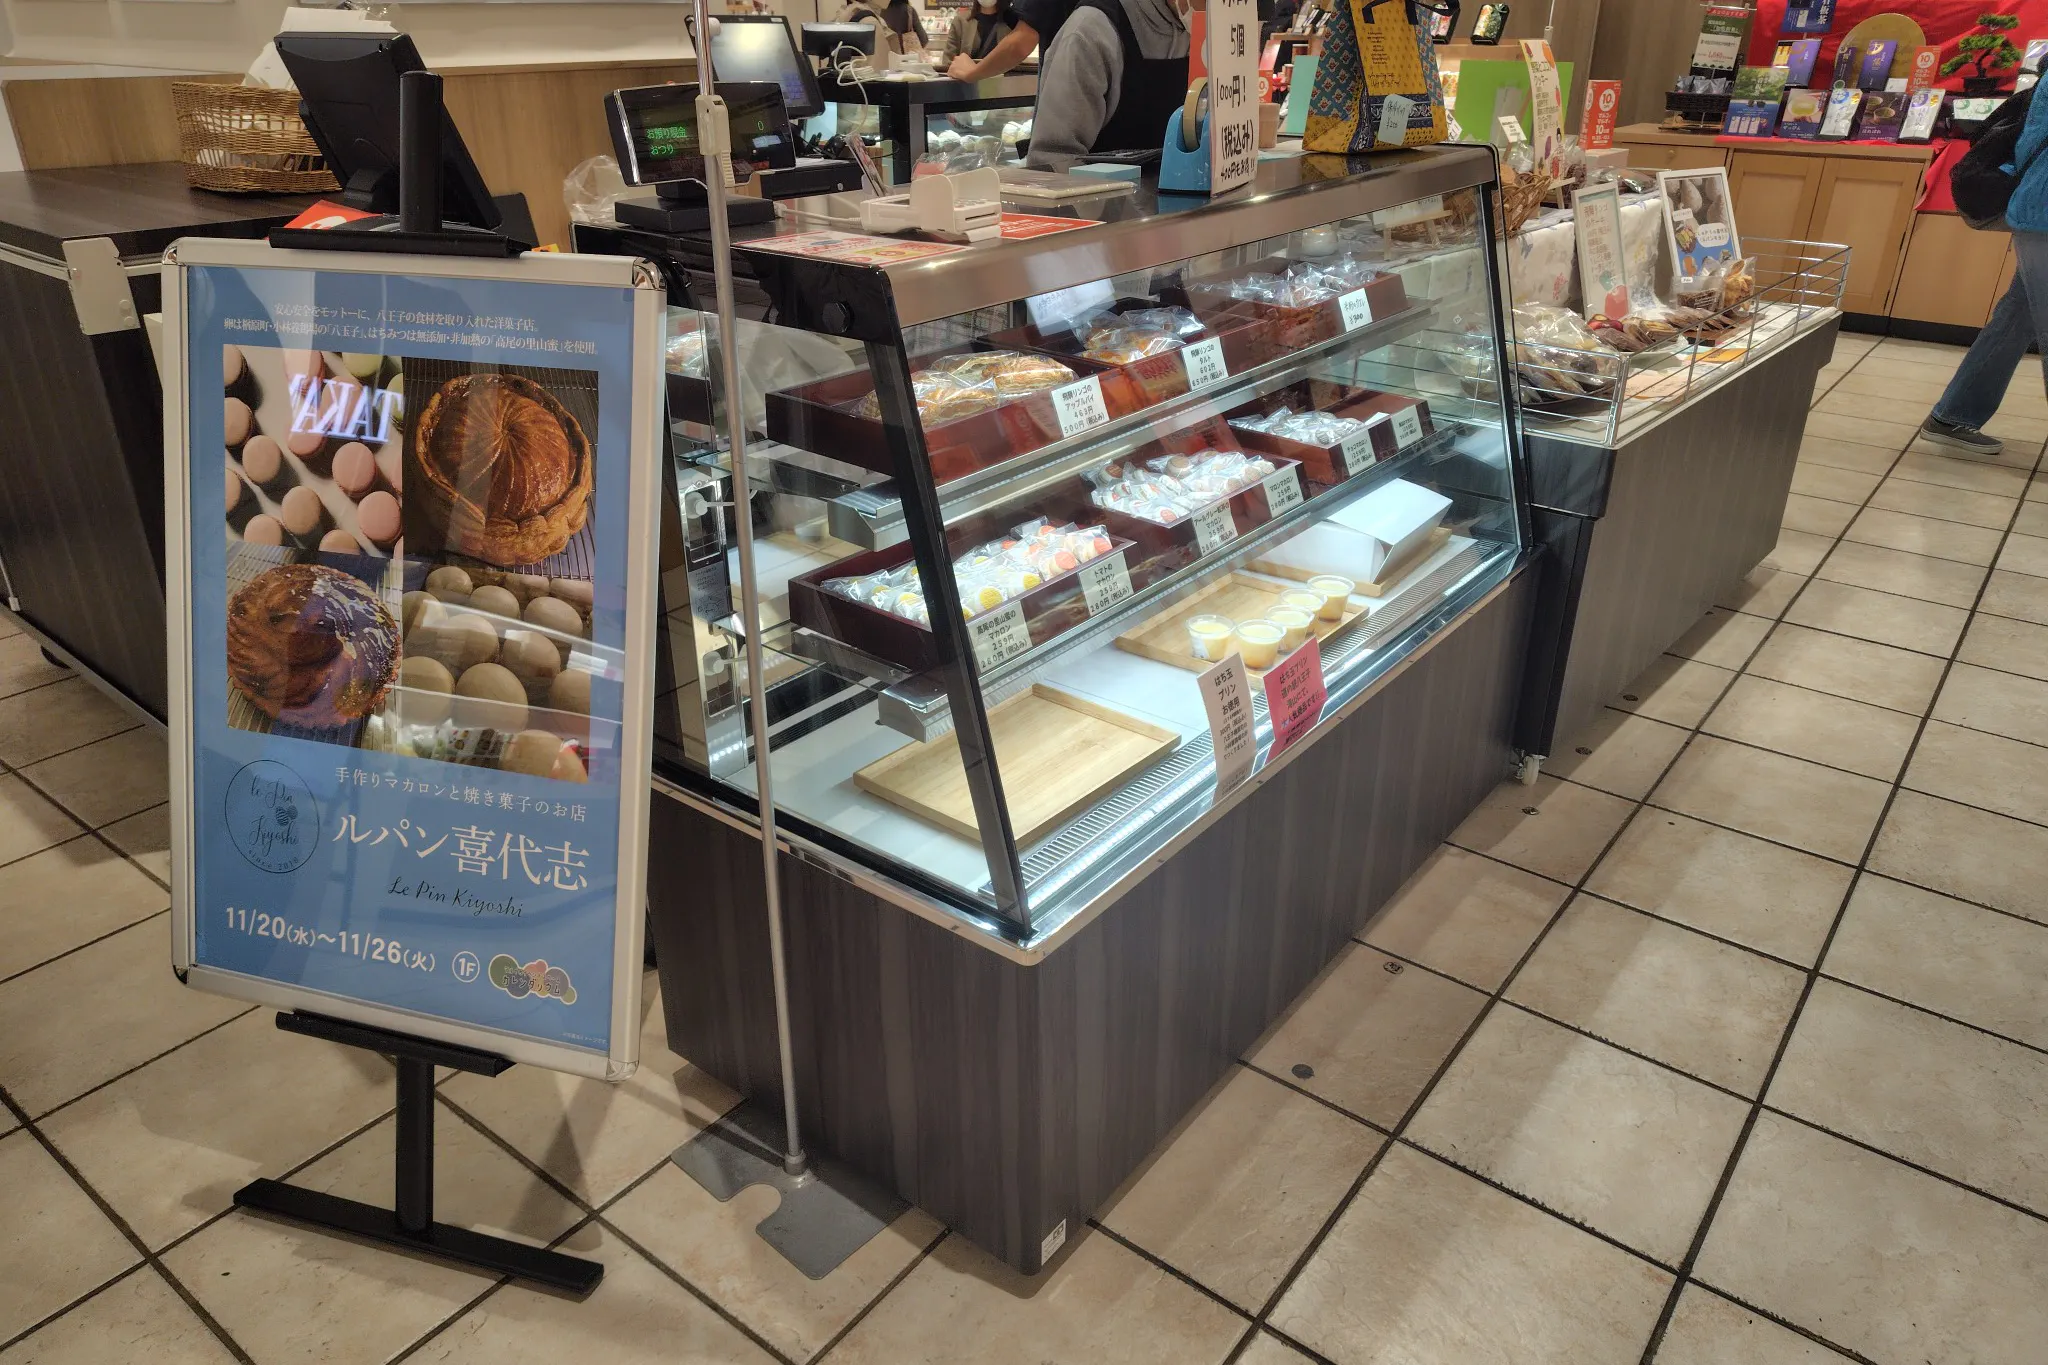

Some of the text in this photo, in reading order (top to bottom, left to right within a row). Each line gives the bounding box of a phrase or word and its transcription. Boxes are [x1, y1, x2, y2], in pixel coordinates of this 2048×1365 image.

[1230, 23, 1245, 57] 5個
[1216, 75, 1246, 108] 1000円!
[646, 126, 687, 140] お預り現金
[1222, 119, 1254, 160] (税込み)
[650, 145, 675, 156] おつり
[1074, 406, 1094, 418] 463円
[1095, 563, 1113, 578] トマトの
[988, 624, 1011, 639] マカロン
[1214, 667, 1234, 687] はち玉
[1218, 684, 1236, 701] プリン
[1222, 696, 1240, 715] お徳用
[335, 767, 587, 822] 手作りマカロンと焼き菓子のお店
[332, 815, 589, 891] ルパン喜代志
[388, 876, 523, 918] Le Pin Kiyoshi
[458, 957, 477, 977] 1F
[502, 975, 560, 994] カレンダリウム
